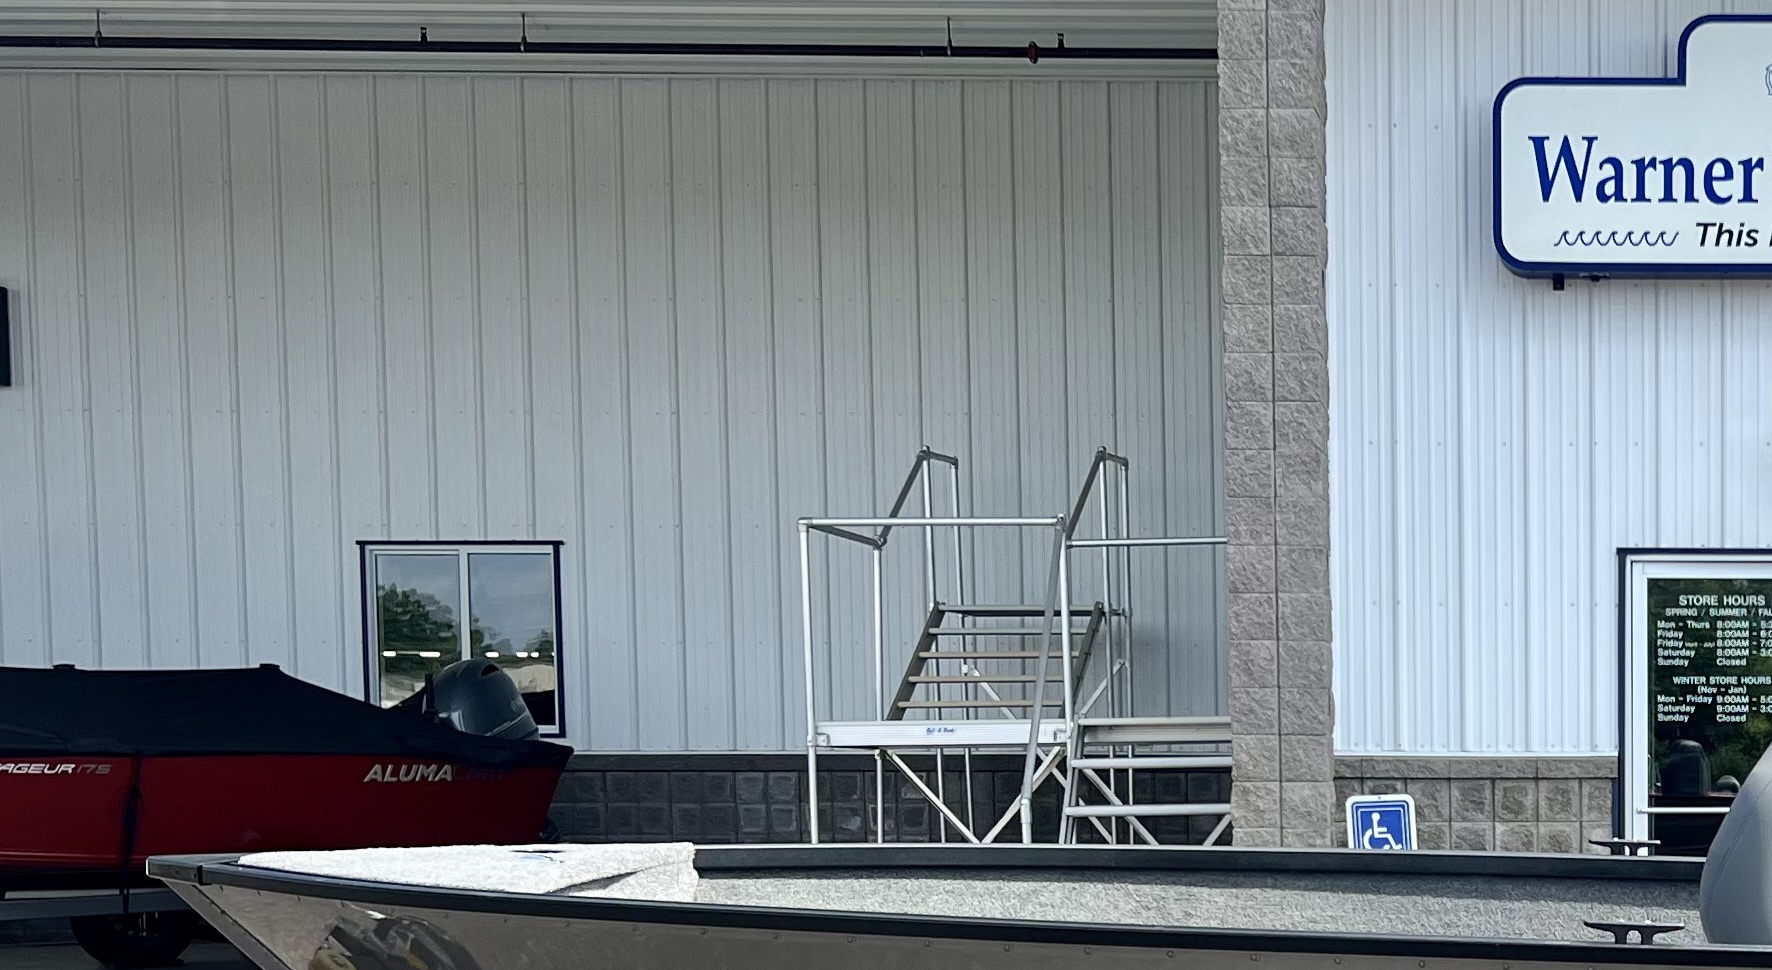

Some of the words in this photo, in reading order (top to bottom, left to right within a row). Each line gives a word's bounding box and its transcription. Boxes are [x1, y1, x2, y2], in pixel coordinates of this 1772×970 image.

[1695, 222, 1759, 248] This
[1678, 594, 1719, 606] STORE
[1723, 594, 1766, 606] HOURS
[1665, 608, 1698, 617] SPRING
[1709, 608, 1747, 617] SUMMER
[1657, 620, 1676, 629] Mon
[1657, 629, 1684, 639] Friday
[1657, 639, 1684, 648] Friday
[1657, 648, 1696, 658] Saturday
[1657, 658, 1689, 667] Sunday
[1716, 658, 1747, 666] Closed
[1672, 676, 1706, 685] WINTER
[1709, 676, 1738, 685] STORE
[1740, 676, 1772, 685] HOURS
[1657, 694, 1676, 703] Mon
[1686, 694, 1713, 704] Friday
[1657, 704, 1696, 713] Saturday
[1657, 714, 1689, 723] Sunday
[1716, 714, 1747, 722] Closed
